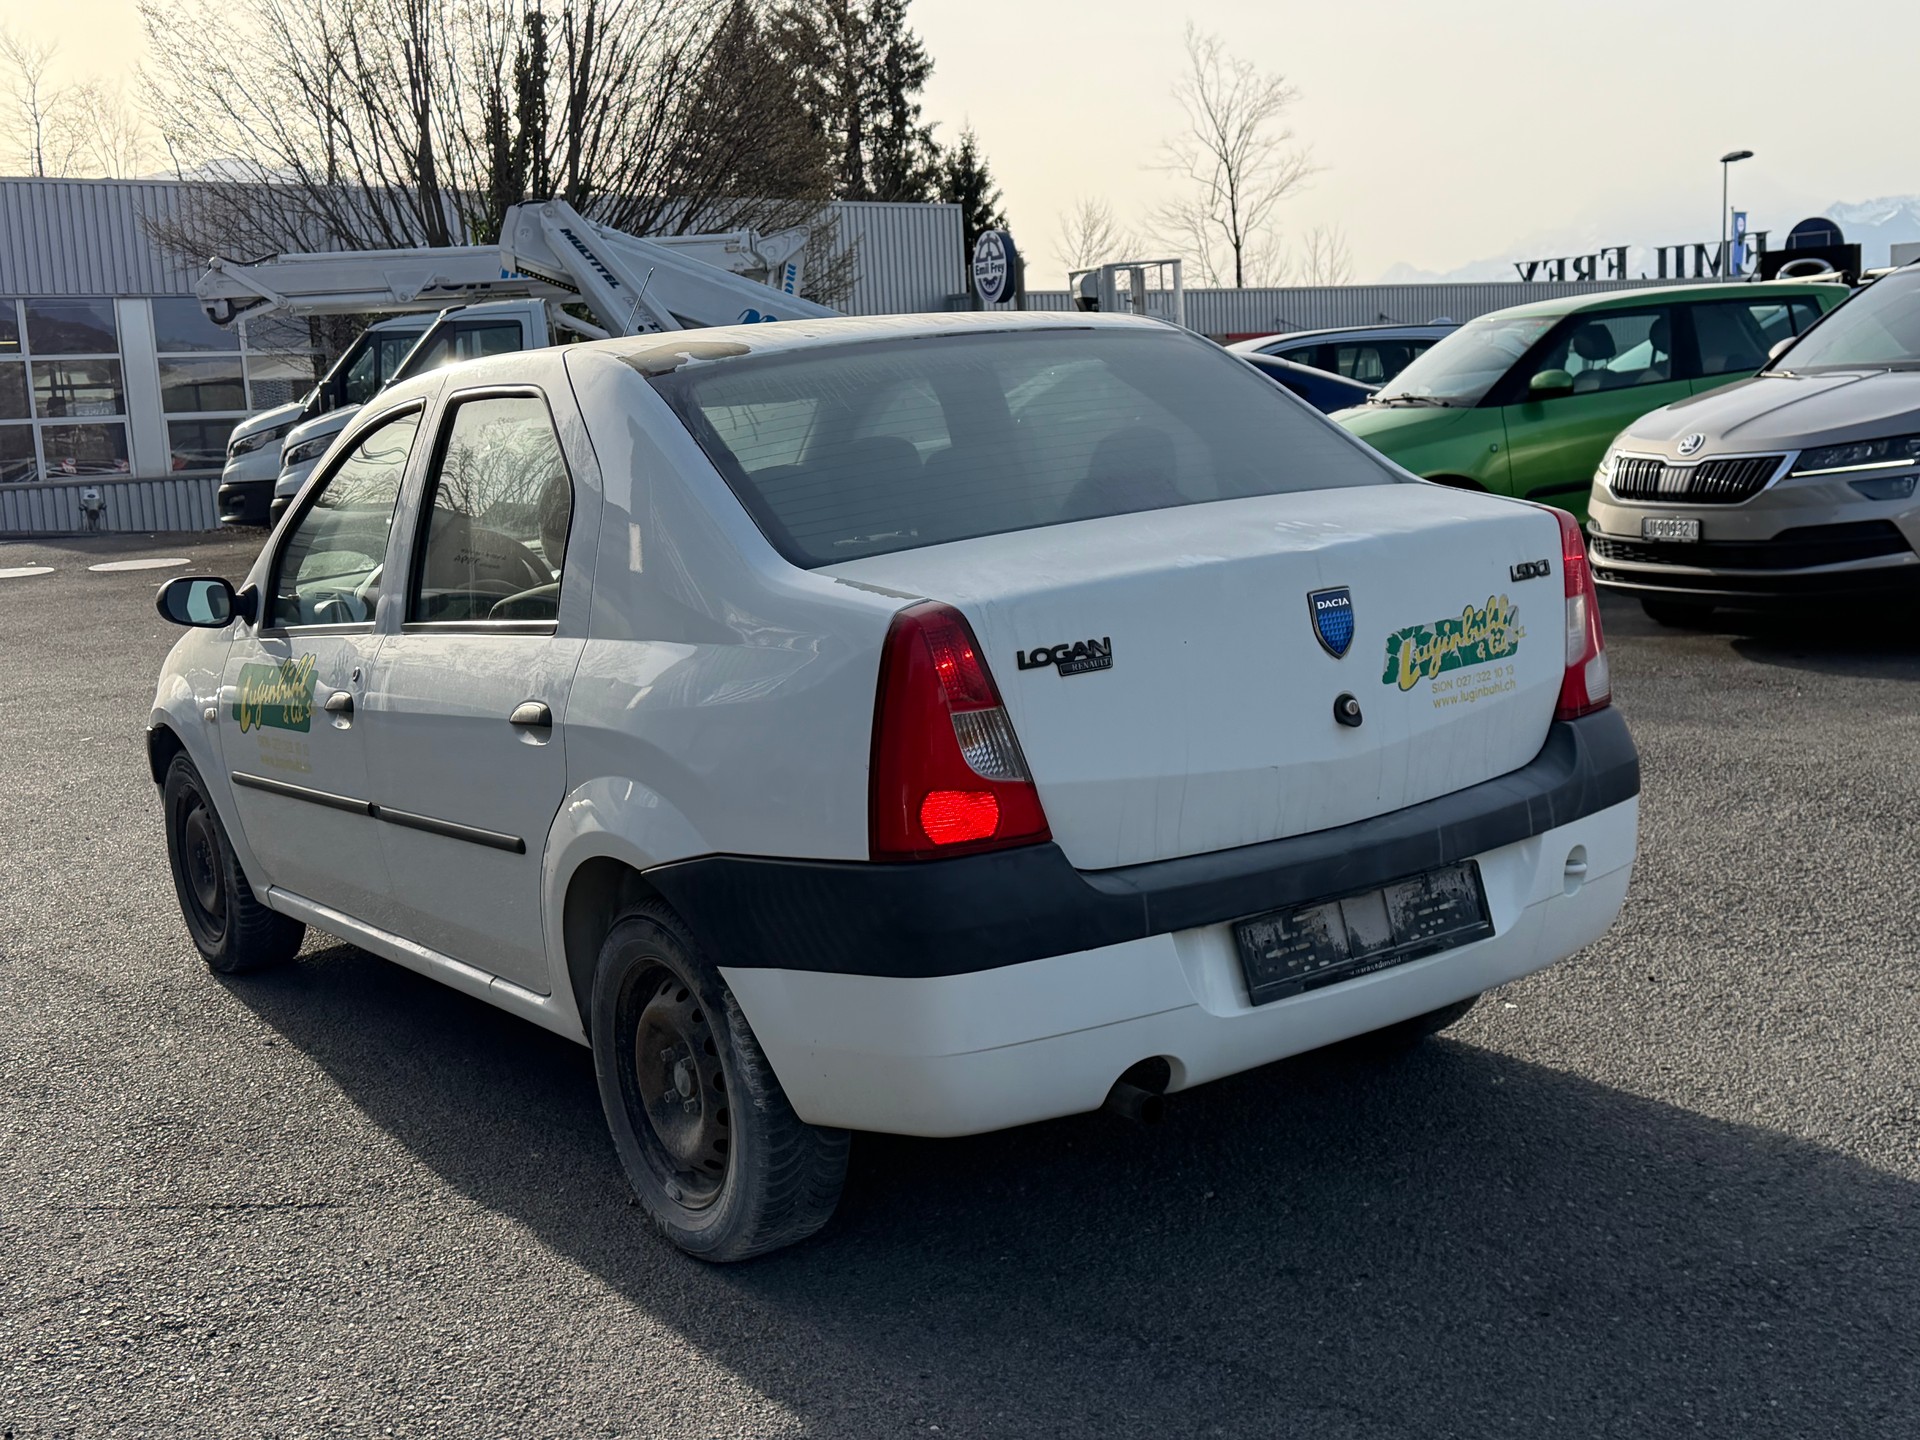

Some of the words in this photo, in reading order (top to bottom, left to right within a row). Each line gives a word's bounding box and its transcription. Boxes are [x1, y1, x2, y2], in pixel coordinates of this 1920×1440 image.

[558, 227, 621, 290] MULTITEL
[975, 262, 990, 276] Emil
[990, 261, 1005, 275] Frey
[1317, 597, 1350, 610] DACIA
[1016, 636, 1111, 670] LOGAN
[1477, 641, 1486, 659] &
[1071, 657, 1109, 672] RENAULT
[1431, 679, 1453, 694] SION
[1493, 667, 1503, 679] 10
[1505, 664, 1515, 676] 13
[1432, 678, 1516, 709] www.luginbuhl.ch
